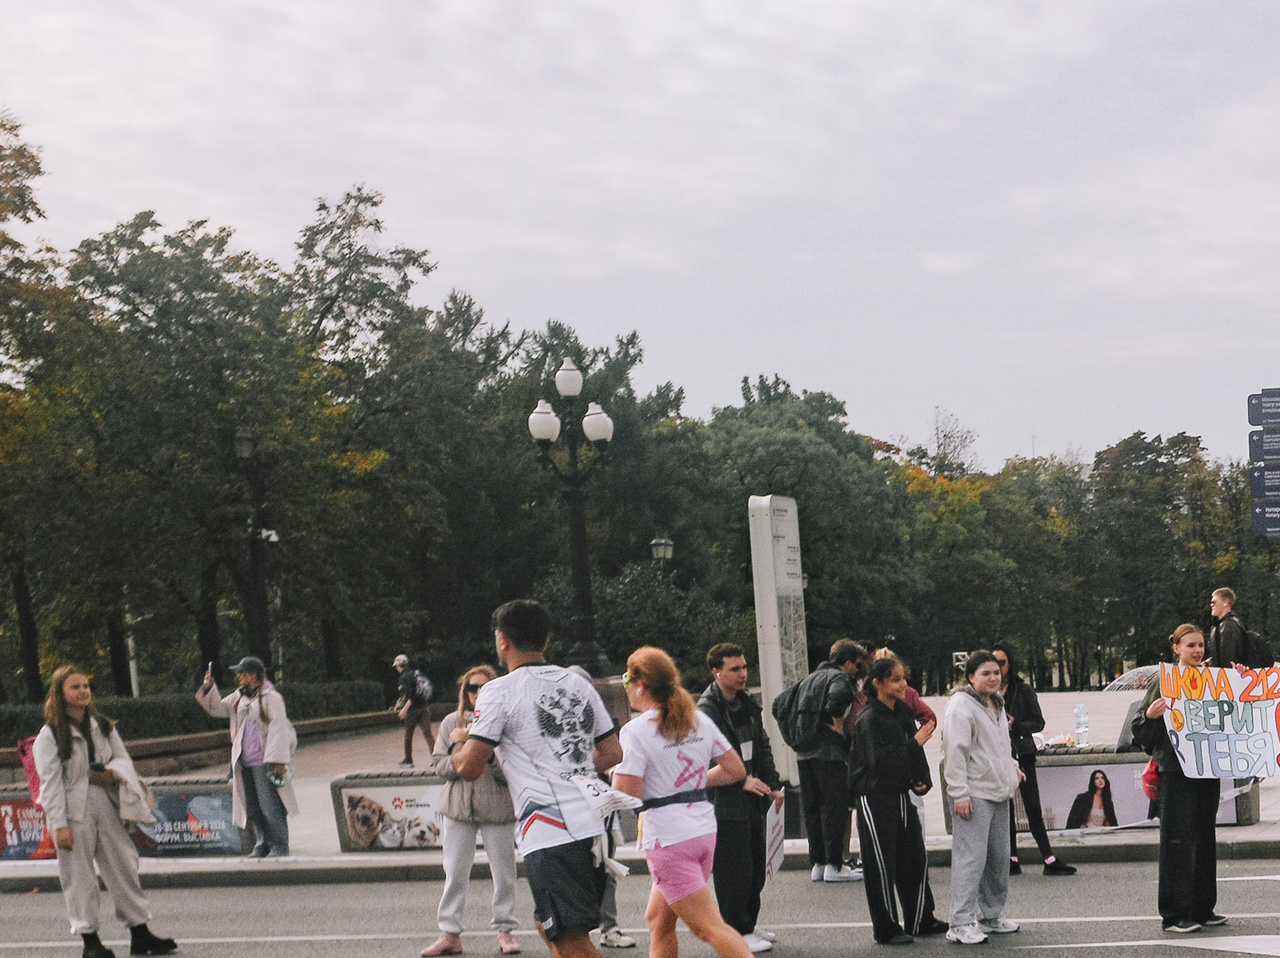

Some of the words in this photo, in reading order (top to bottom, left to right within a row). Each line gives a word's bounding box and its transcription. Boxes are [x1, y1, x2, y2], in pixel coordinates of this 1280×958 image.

[1160, 662, 1234, 701] ШКОЛА
[1183, 699, 1275, 734] ВЕРИТ
[1185, 731, 1276, 777] ТЕБЯ
